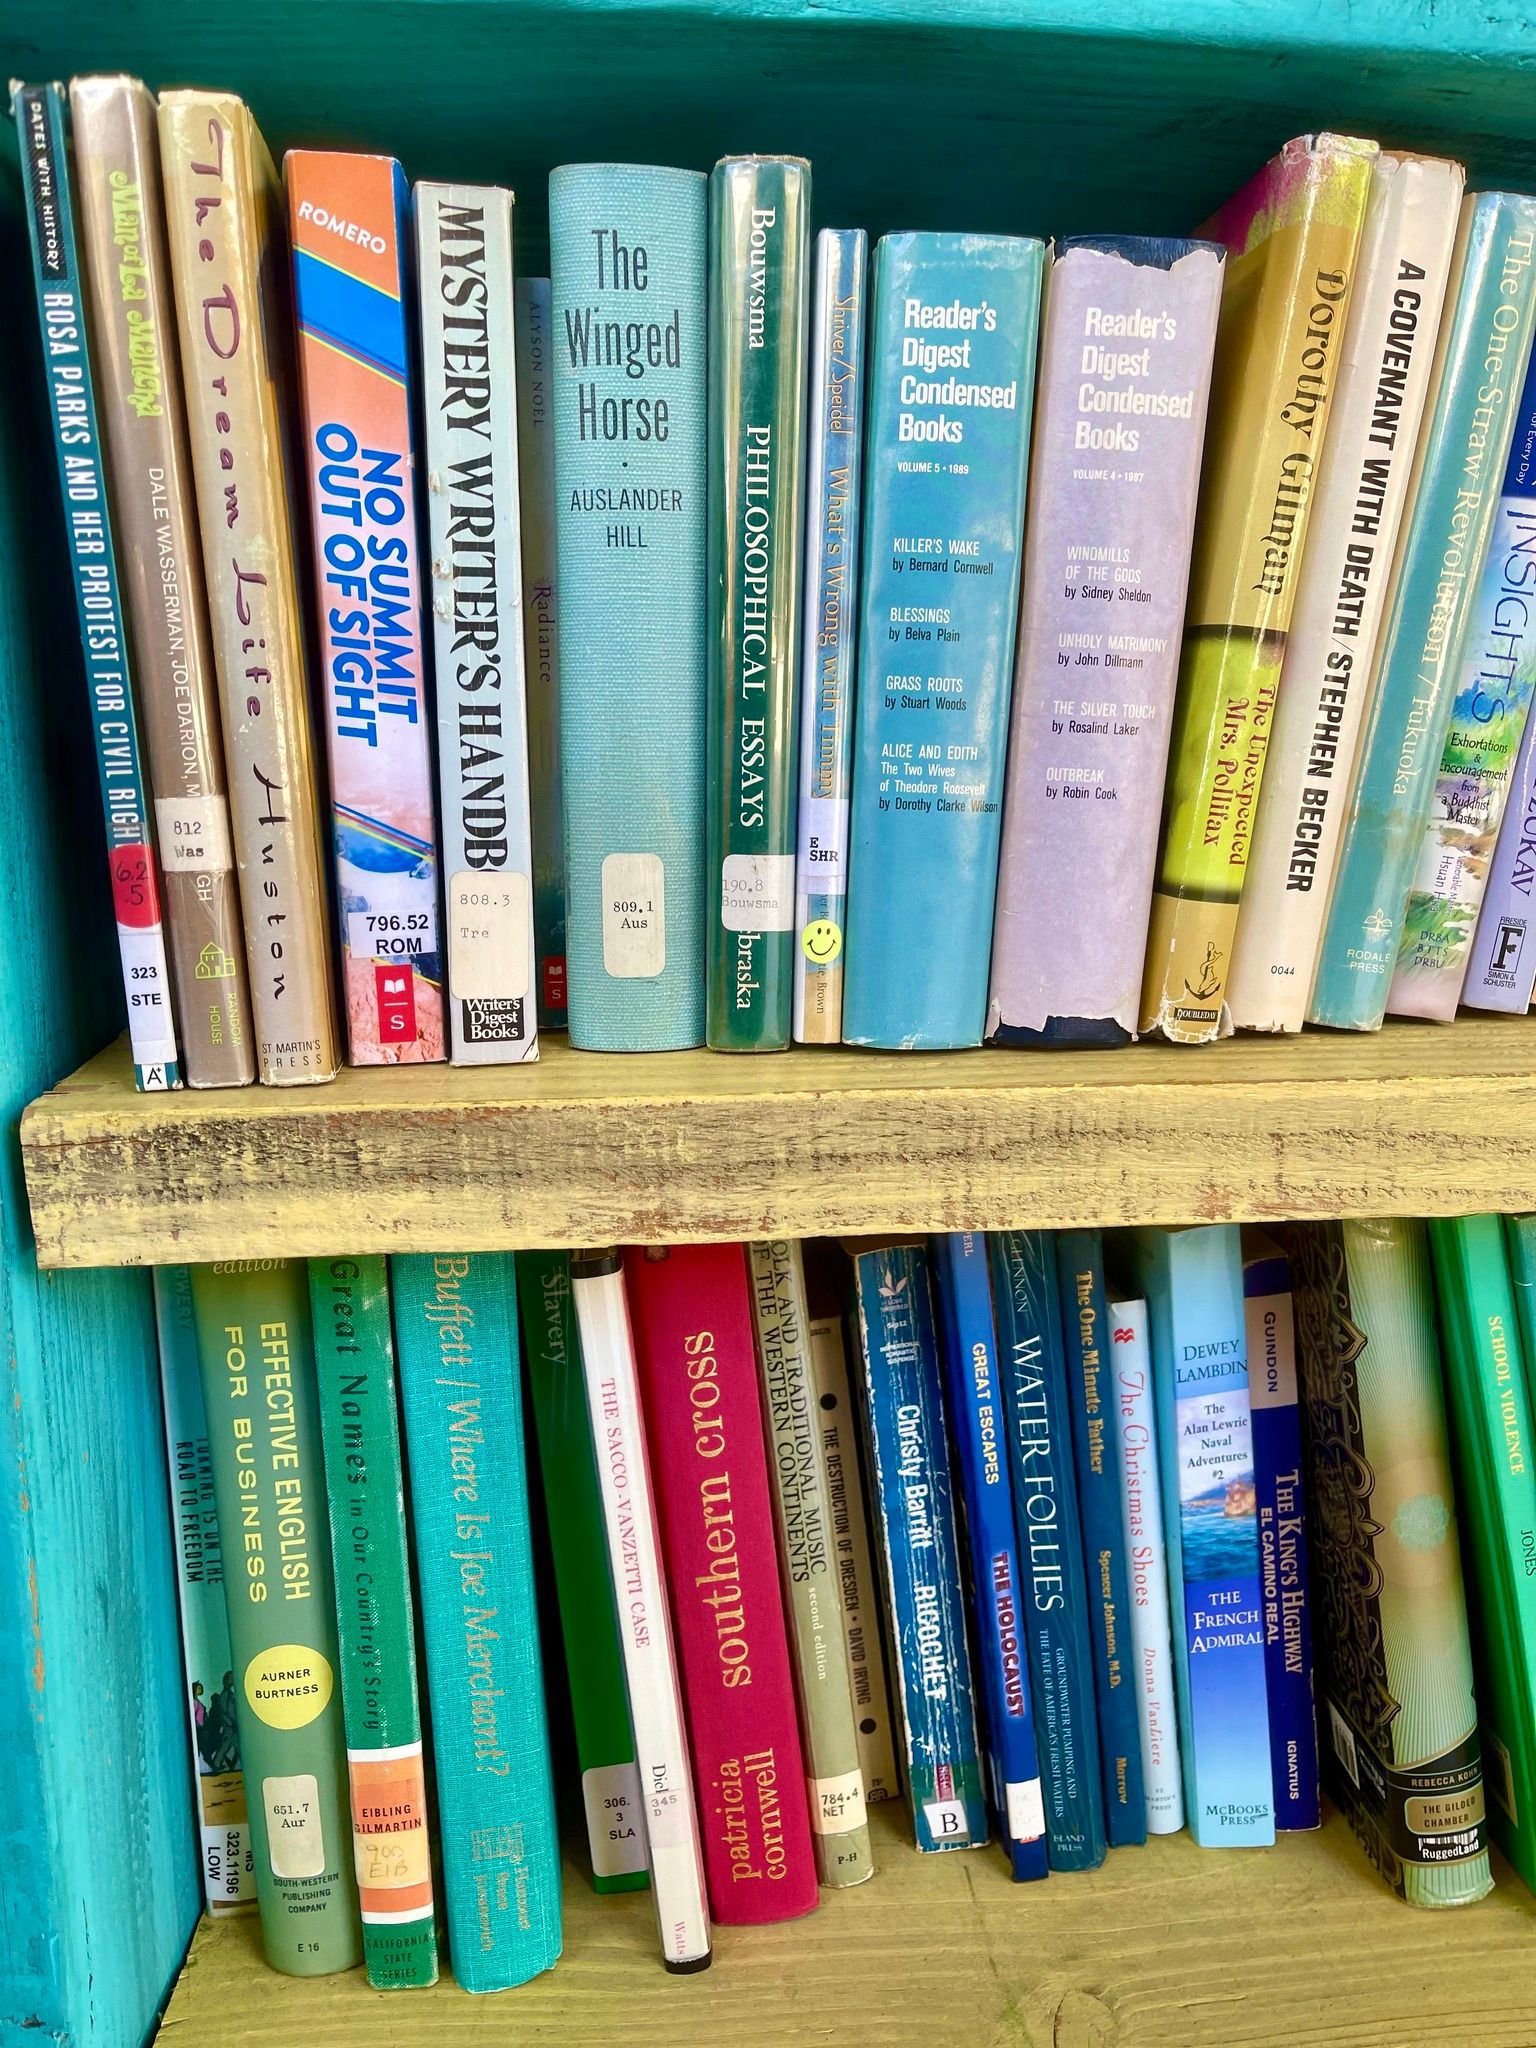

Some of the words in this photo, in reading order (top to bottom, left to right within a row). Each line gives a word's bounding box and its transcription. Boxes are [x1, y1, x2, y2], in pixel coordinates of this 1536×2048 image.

[30, 102, 46, 149] DATES
[36, 158, 52, 196] WITH
[190, 118, 224, 263] The
[42, 205, 60, 271] HISTORY
[298, 200, 387, 256] ROMERO
[591, 229, 647, 291] The
[749, 206, 775, 350] Bouwsma
[1398, 259, 1426, 281] A
[1500, 231, 1533, 294] The
[44, 293, 78, 356] ROSA
[438, 200, 492, 442] MYSTERY
[905, 298, 997, 331] Reader's
[1084, 307, 1176, 340] Reader's
[564, 309, 680, 379] Winged
[902, 337, 971, 373] Digest
[1081, 346, 1150, 381] Digest
[1280, 267, 1348, 440] Dorothy
[900, 375, 1016, 410] Condensed
[1368, 289, 1421, 450] COVENANT
[1463, 303, 1520, 480] One-Straw
[53, 367, 91, 443] PARKS
[203, 283, 239, 529] Dream
[578, 383, 668, 442] Horse
[1078, 383, 1193, 419] Condensed
[898, 413, 963, 443] Books
[1074, 421, 1140, 452] Books
[64, 456, 98, 500] AND
[149, 468, 169, 521] DALE
[316, 423, 364, 527] OUT
[360, 448, 405, 525] NO
[1351, 459, 1391, 536] WITH
[570, 488, 682, 512] AUSLANDER
[71, 512, 105, 554] HER
[606, 526, 647, 548] HILL
[893, 537, 943, 554] KILLER'S
[949, 540, 980, 556] WAKE
[1252, 453, 1315, 595] Gilman
[324, 534, 367, 600] OF
[444, 452, 502, 692] WRITER'S
[741, 424, 772, 700] PHILOSOPHICAL
[1421, 488, 1482, 664] Revolution
[79, 565, 119, 661] PROTEST
[156, 525, 184, 656] WASSERMAN,
[232, 558, 271, 718] Life
[367, 535, 418, 724] SUMMIT
[890, 607, 950, 623] BLESSINGS
[94, 672, 125, 710] FOR
[171, 659, 188, 698] JOE
[329, 606, 378, 747] SIGHT
[1219, 697, 1249, 751] Mrs.
[1255, 683, 1276, 726] The
[100, 722, 133, 778] CIVIL
[176, 703, 199, 779] DARION,
[881, 744, 913, 758] ALICE
[918, 745, 941, 759] AND
[947, 747, 978, 760] EDITH
[1392, 695, 1428, 796] Fukuoka
[1450, 732, 1508, 754] Exhortations
[740, 717, 765, 828] ESSAYS
[1202, 758, 1240, 847] Pollifax
[1228, 731, 1267, 867] Unexpected
[174, 821, 201, 834] 812
[1285, 788, 1329, 892] BECKER
[460, 894, 510, 905] 808.3
[613, 902, 653, 914] 809.1
[621, 916, 647, 929] Aus
[366, 914, 429, 932] 796.52
[376, 938, 422, 954] ROM
[461, 928, 489, 938] Tre
[131, 967, 157, 979] 323
[1347, 948, 1390, 962] RODALE
[1349, 961, 1385, 973] PRESS
[131, 994, 162, 1006] STE
[226, 992, 244, 1048] RANDOM
[209, 1005, 223, 1045] HOUSE
[756, 1270, 777, 1317] THE
[1076, 1270, 1094, 1306] The
[540, 1271, 570, 1365] Slavery
[777, 1299, 797, 1344] AND
[1079, 1309, 1095, 1346] One
[224, 1326, 248, 1398] FOR
[972, 1342, 991, 1400] GREAT
[1176, 1359, 1248, 1384] LAMBDIN
[1183, 1340, 1240, 1361] DEWEY
[1264, 1311, 1278, 1393] GUINDON
[260, 1322, 299, 1470] EFFECTIVE
[601, 1377, 619, 1420] THE
[685, 1330, 725, 1458] cross
[763, 1327, 794, 1433] WESTERN
[1012, 1335, 1050, 1466] WATER
[1082, 1350, 1101, 1414] Minute
[1119, 1371, 1144, 1417] The
[1488, 1315, 1510, 1386] SCHOOL
[1500, 1388, 1525, 1476] VIOLENCE
[785, 1350, 818, 1500] TRADITIONAL
[1183, 1424, 1208, 1436] Alan
[1212, 1417, 1248, 1431] Lewrie
[1204, 1404, 1224, 1415] The
[824, 1426, 838, 1448] THE
[897, 1405, 926, 1478] Christy
[978, 1405, 999, 1485] ESCAPES
[1087, 1419, 1104, 1474] Father
[1188, 1451, 1248, 1469] Adventures
[1201, 1435, 1232, 1450] Naval
[827, 1454, 849, 1534] DESTRUCTION
[1123, 1424, 1149, 1536] Christmas
[1212, 1469, 1224, 1480] #2
[232, 1418, 267, 1603] BUSINESS
[606, 1427, 643, 1595] SACCO-VANZETTI
[777, 1442, 809, 1582] CONTINENTS
[1260, 1507, 1272, 1524] EL
[274, 1479, 310, 1600] ENGLISH
[804, 1508, 826, 1574] MUSIC
[837, 1539, 852, 1553] OF
[1024, 1476, 1064, 1612] FOLLIES
[1261, 1527, 1277, 1598] CAMINO
[695, 1471, 751, 1688] southern
[841, 1559, 859, 1611] DRESDEN
[991, 1552, 1010, 1592] THE
[1131, 1546, 1154, 1607] Shoes
[808, 1586, 822, 1631] second
[1208, 1591, 1241, 1606] THE
[631, 1601, 650, 1648] CASE
[848, 1627, 866, 1663] DAVID
[1265, 1602, 1279, 1644] REAL
[260, 1668, 311, 1682] AURNER
[814, 1634, 826, 1680] edition
[997, 1596, 1024, 1718] HOLOCAUST
[255, 1684, 319, 1700] BURTNESS
[854, 1669, 870, 1706] IRVING
[1287, 1740, 1299, 1800] IGNATIUS
[1411, 1776, 1455, 1787] REBECCA
[1458, 1767, 1478, 1781] KOHN
[273, 1804, 309, 1815] 651.7
[362, 1804, 411, 1819] EIBLING
[744, 1747, 787, 1881] cornwell
[820, 1788, 858, 1805] 784.4
[823, 1806, 845, 1817] NET
[1422, 1804, 1441, 1815] THE
[1445, 1796, 1475, 1812] GILDED
[281, 1817, 305, 1828] Aur
[354, 1817, 421, 1833] GILMARTIN
[609, 1829, 636, 1840] SLA
[713, 1758, 762, 1882] patricia
[942, 1813, 958, 1833] B
[1424, 1814, 1469, 1828] CHAMBER
[208, 1847, 221, 1880] LOW
[226, 1832, 239, 1894] 323.1196
[1423, 1839, 1479, 1859] RuggedLand
[282, 1889, 331, 1900] PUBLISHING
[288, 1902, 327, 1914] COMPANY
